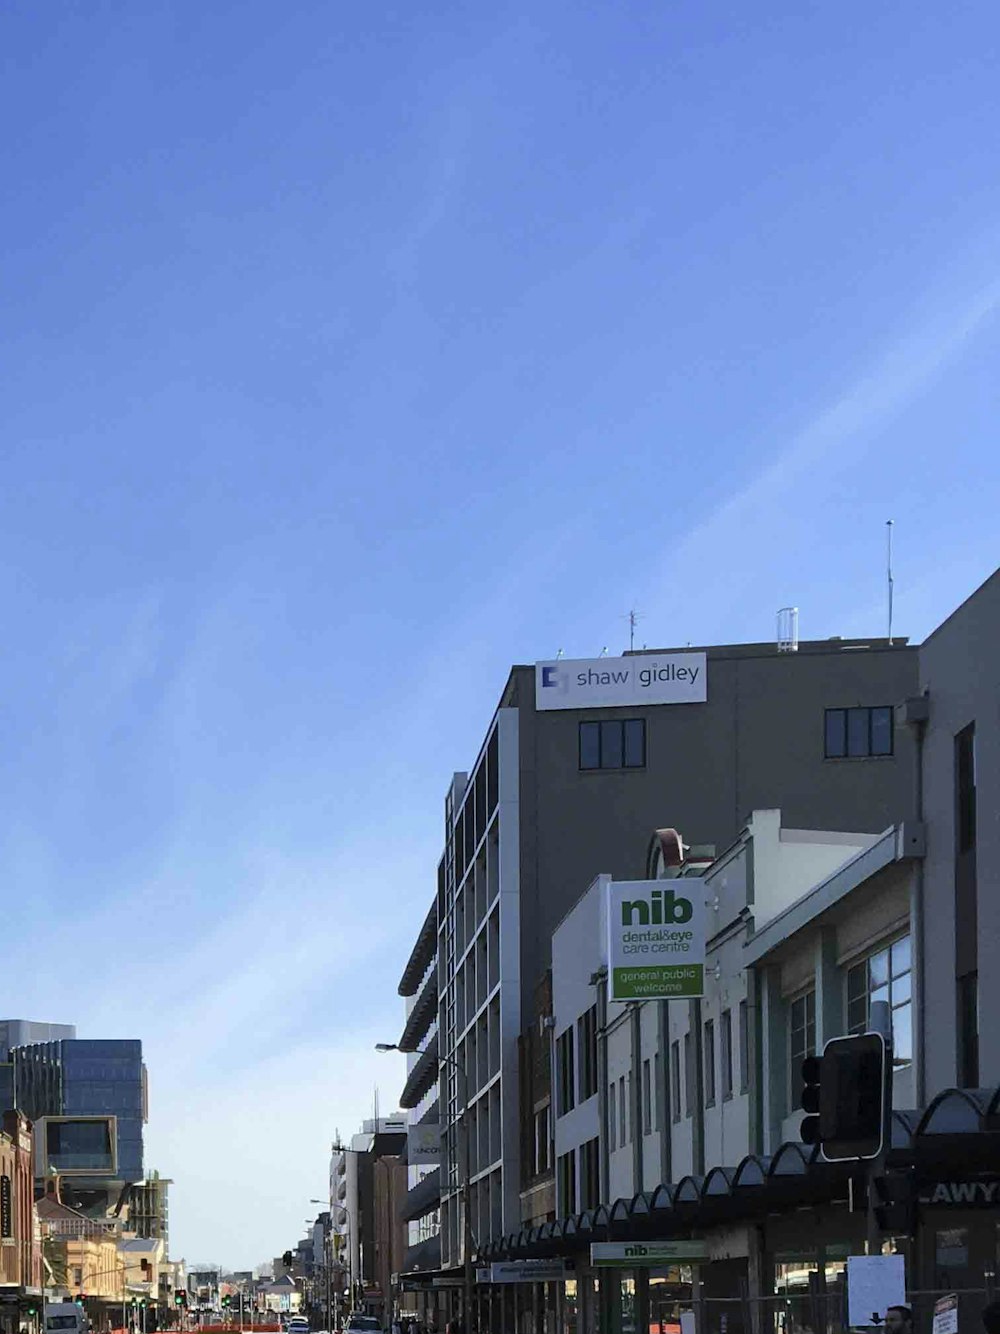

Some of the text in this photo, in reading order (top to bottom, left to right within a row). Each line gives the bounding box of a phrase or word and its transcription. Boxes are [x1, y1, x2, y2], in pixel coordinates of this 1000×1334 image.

[577, 663, 699, 687] shaw gidley
[621, 889, 693, 926] nib
[623, 941, 690, 954] care centre
[620, 969, 696, 983] general public
[633, 983, 682, 993] welcome
[624, 1245, 648, 1257] nib
